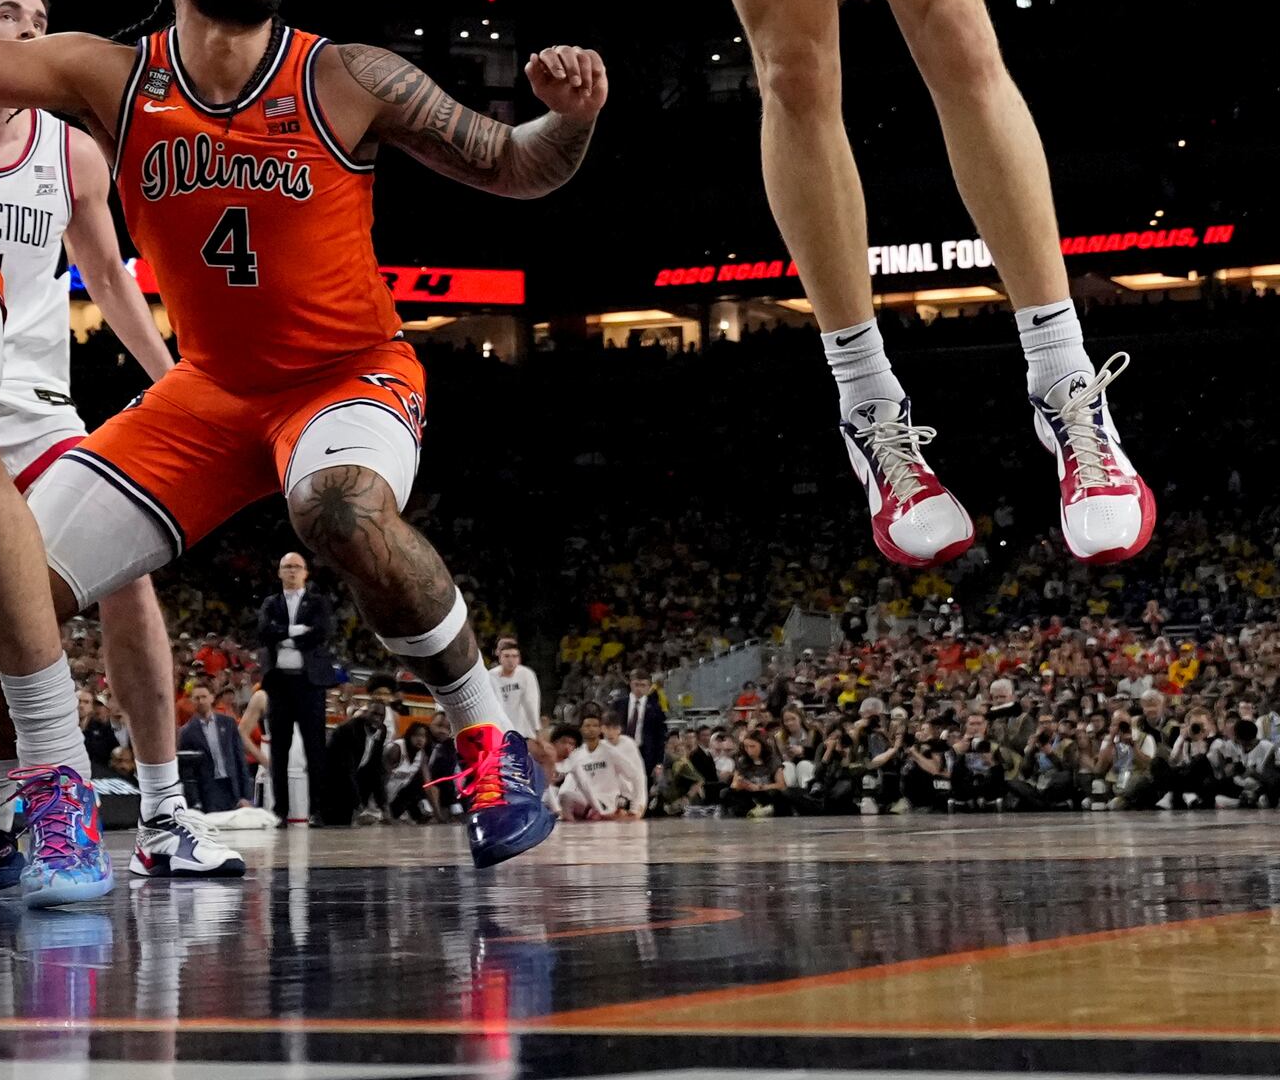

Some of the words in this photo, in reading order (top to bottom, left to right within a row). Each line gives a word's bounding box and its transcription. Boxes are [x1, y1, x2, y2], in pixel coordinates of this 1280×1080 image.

[144, 84, 165, 95] FOUR
[149, 72, 170, 82] FINAL
[140, 132, 313, 201] Illinois
[201, 206, 258, 286] 4
[868, 242, 937, 275] FINAL
[942, 239, 995, 270] FOU
[1203, 225, 1234, 244] IN
